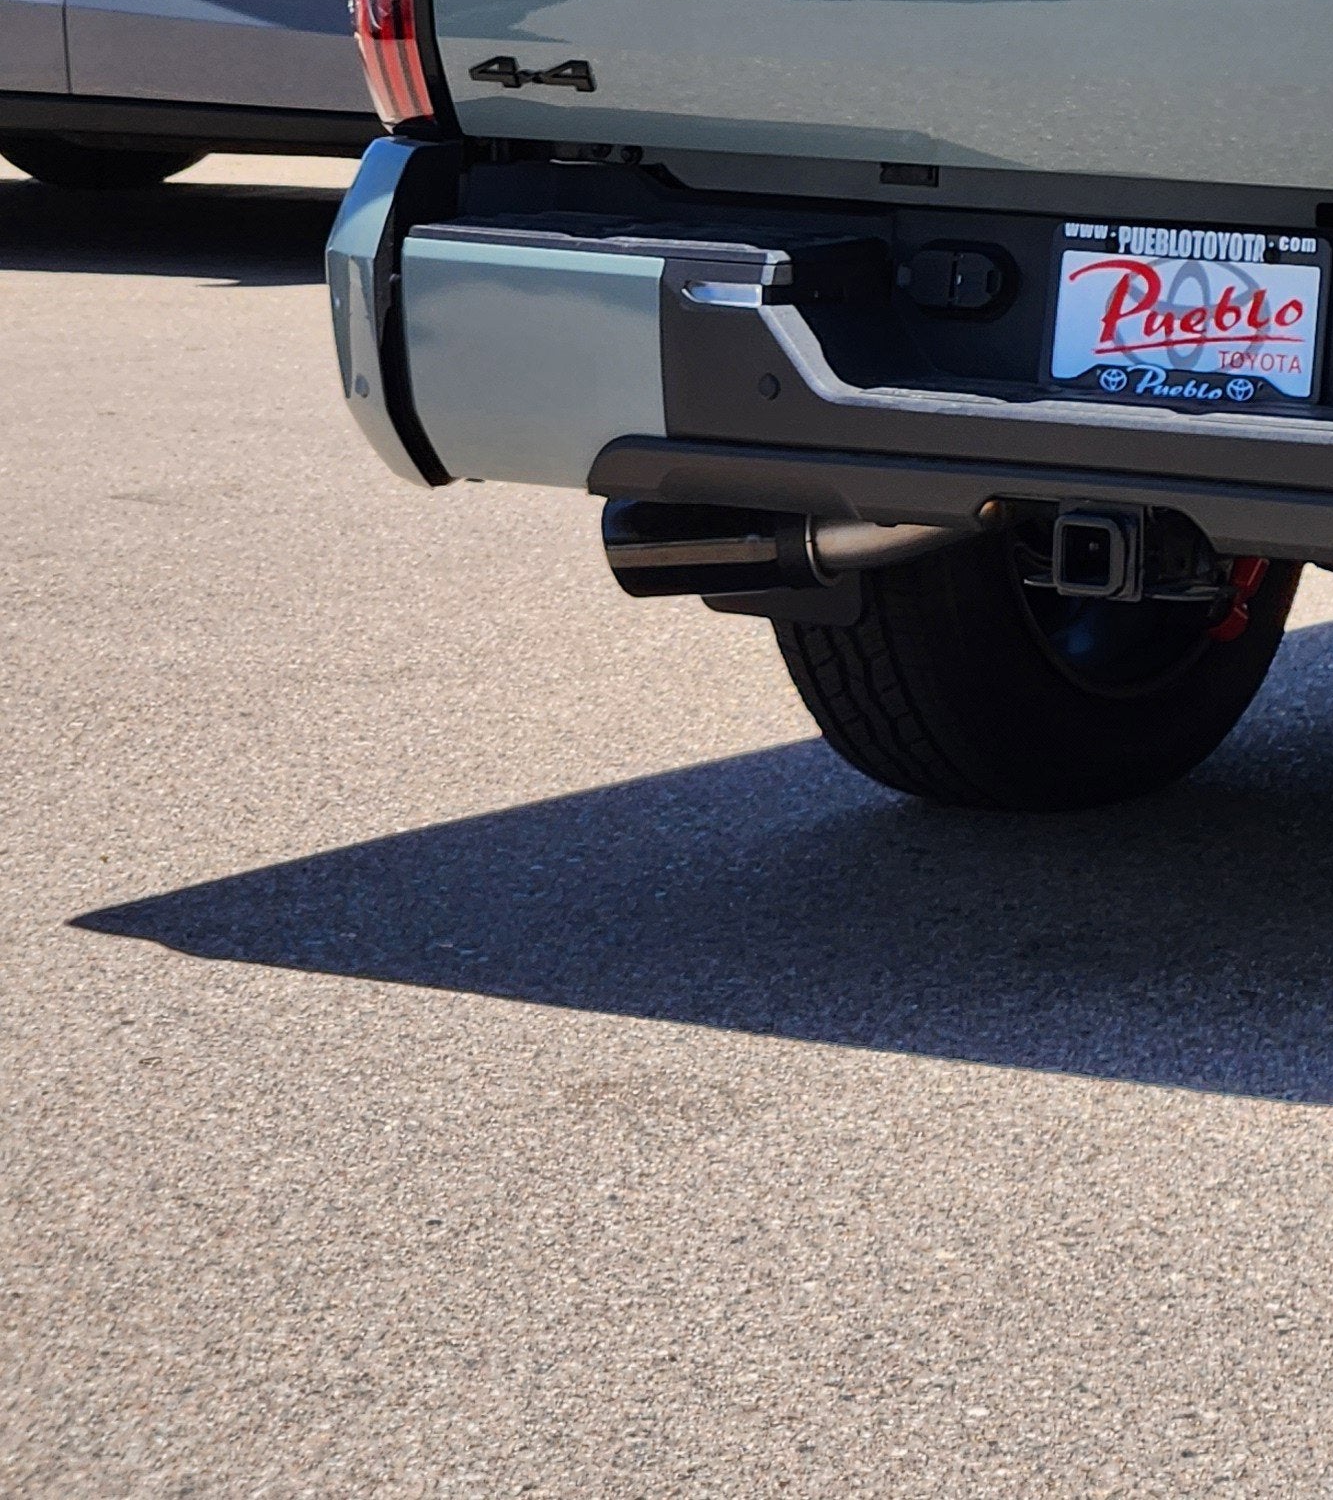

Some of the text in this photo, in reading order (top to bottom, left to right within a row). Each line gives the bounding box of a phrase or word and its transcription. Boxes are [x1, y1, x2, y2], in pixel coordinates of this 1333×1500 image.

[1068, 259, 1304, 344] Pueblo
[1218, 350, 1303, 374] TOYOTA
[1126, 364, 1223, 401] Pueblo
